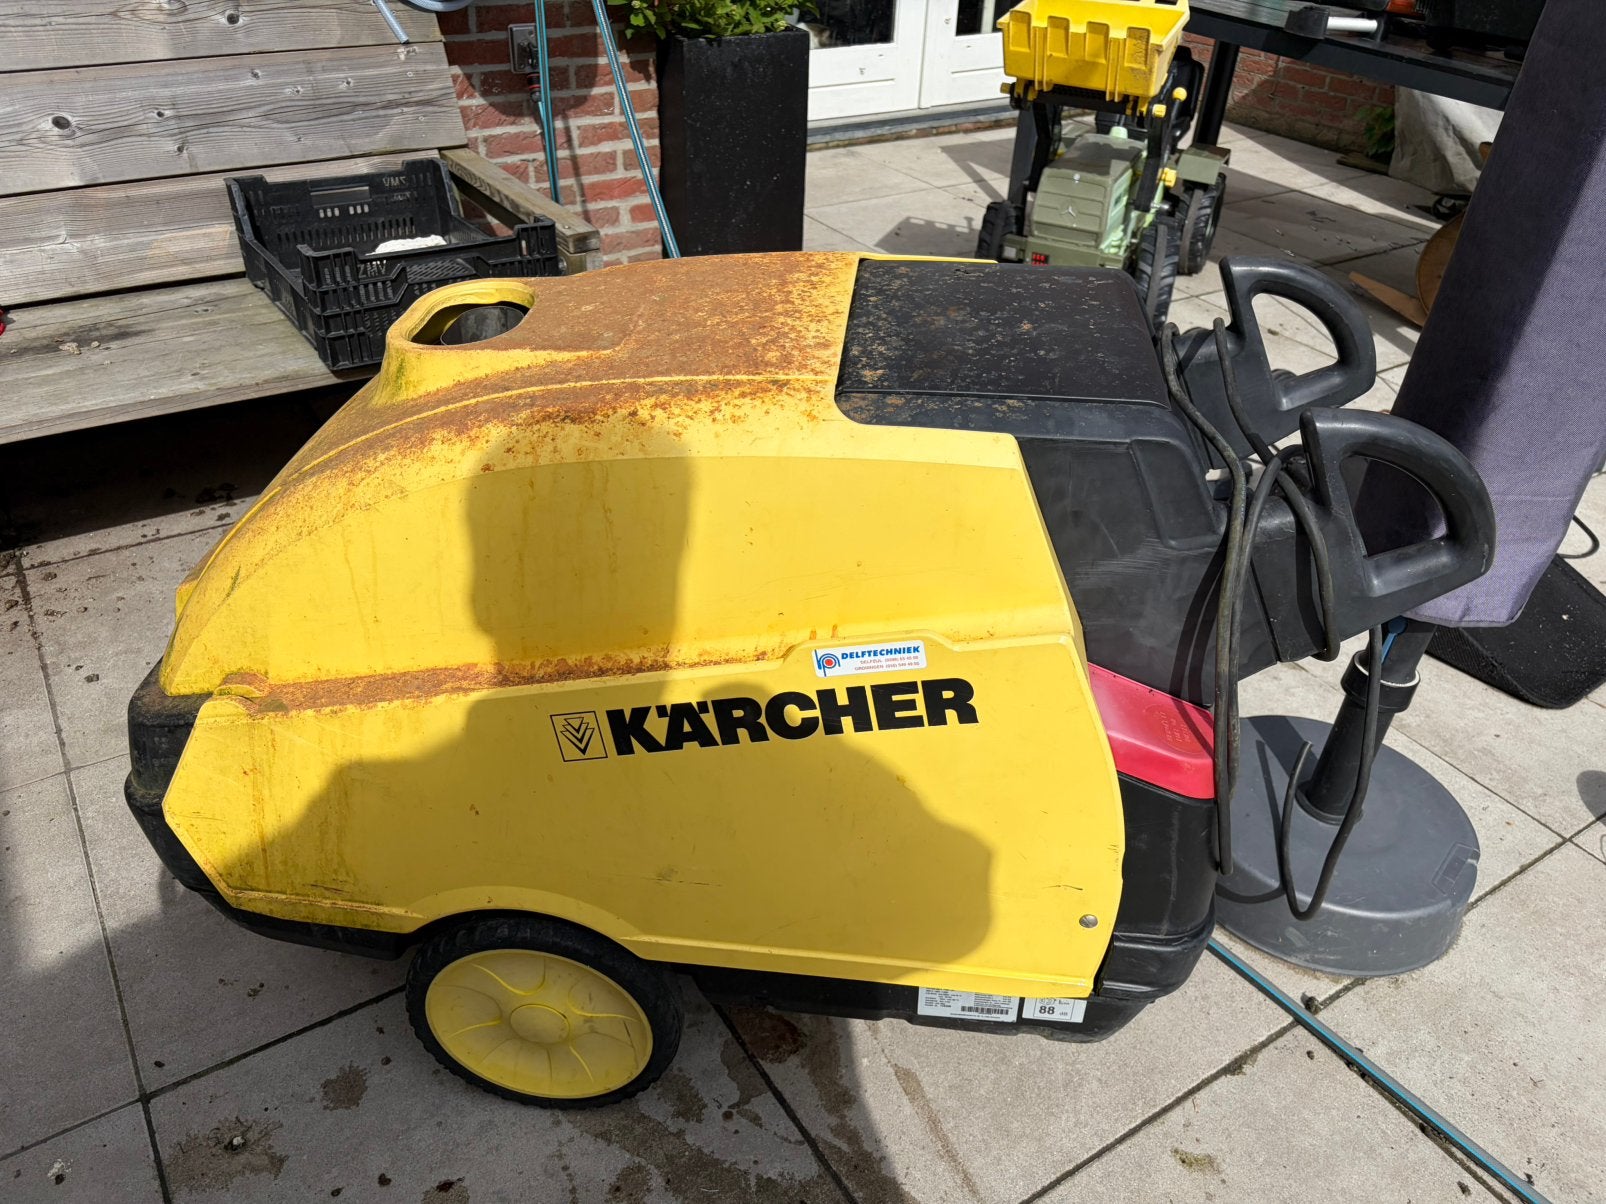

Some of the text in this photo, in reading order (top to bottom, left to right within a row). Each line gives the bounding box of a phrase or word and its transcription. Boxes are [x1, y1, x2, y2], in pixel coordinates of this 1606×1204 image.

[357, 260, 387, 279] ZMV
[841, 646, 920, 660] DELFTECHNIEK
[606, 677, 979, 755] KÄRCHER
[1039, 1005, 1056, 1015] 88
